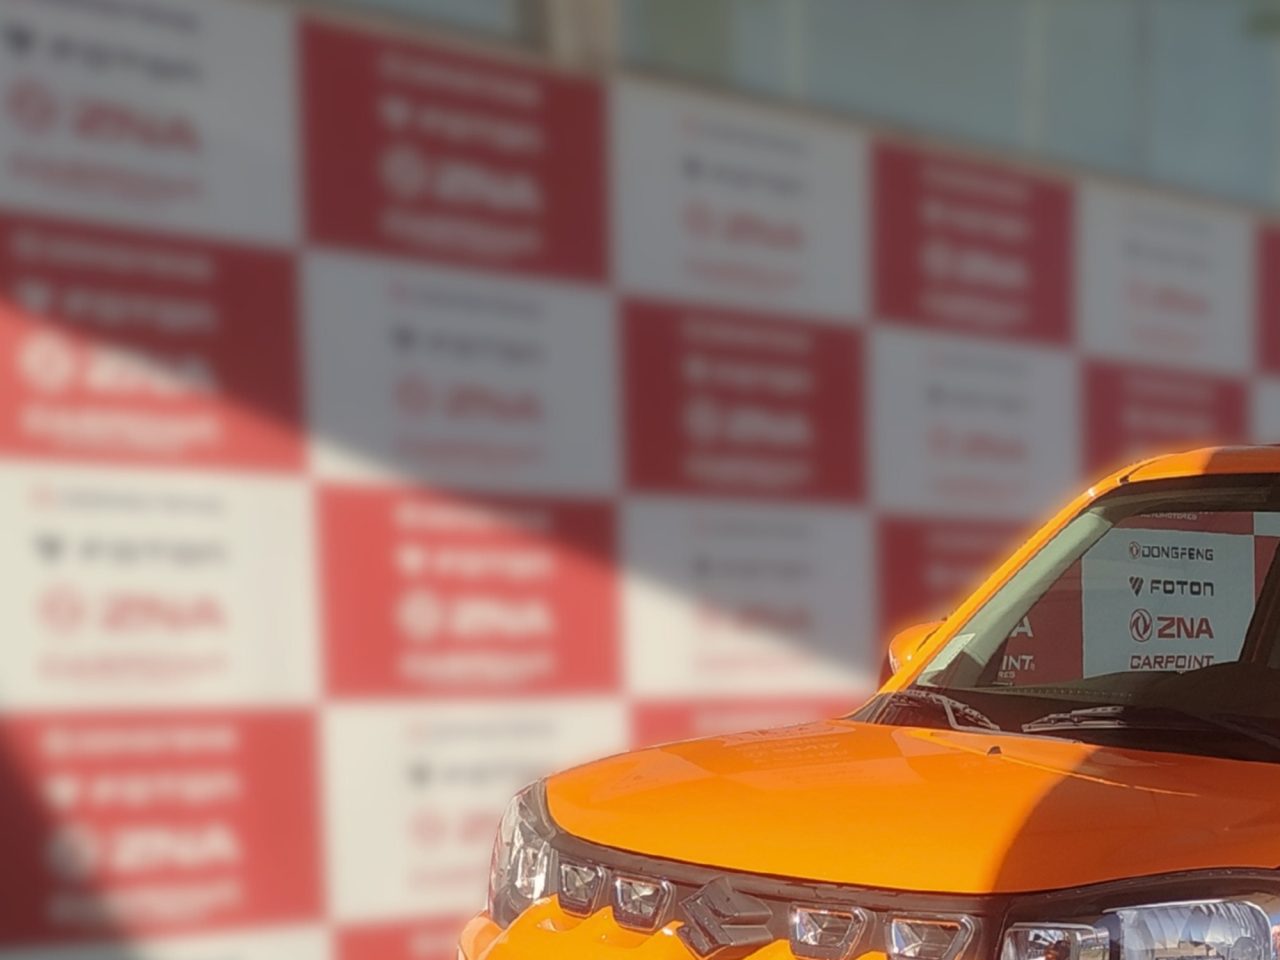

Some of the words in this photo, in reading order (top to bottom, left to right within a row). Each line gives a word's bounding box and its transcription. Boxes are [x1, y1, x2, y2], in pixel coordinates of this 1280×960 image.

[1141, 544, 1214, 561] DONGFENG
[1150, 578, 1215, 597] FOTON
[1157, 616, 1215, 639] ZNA
[1130, 654, 1215, 670] CARPOINT
